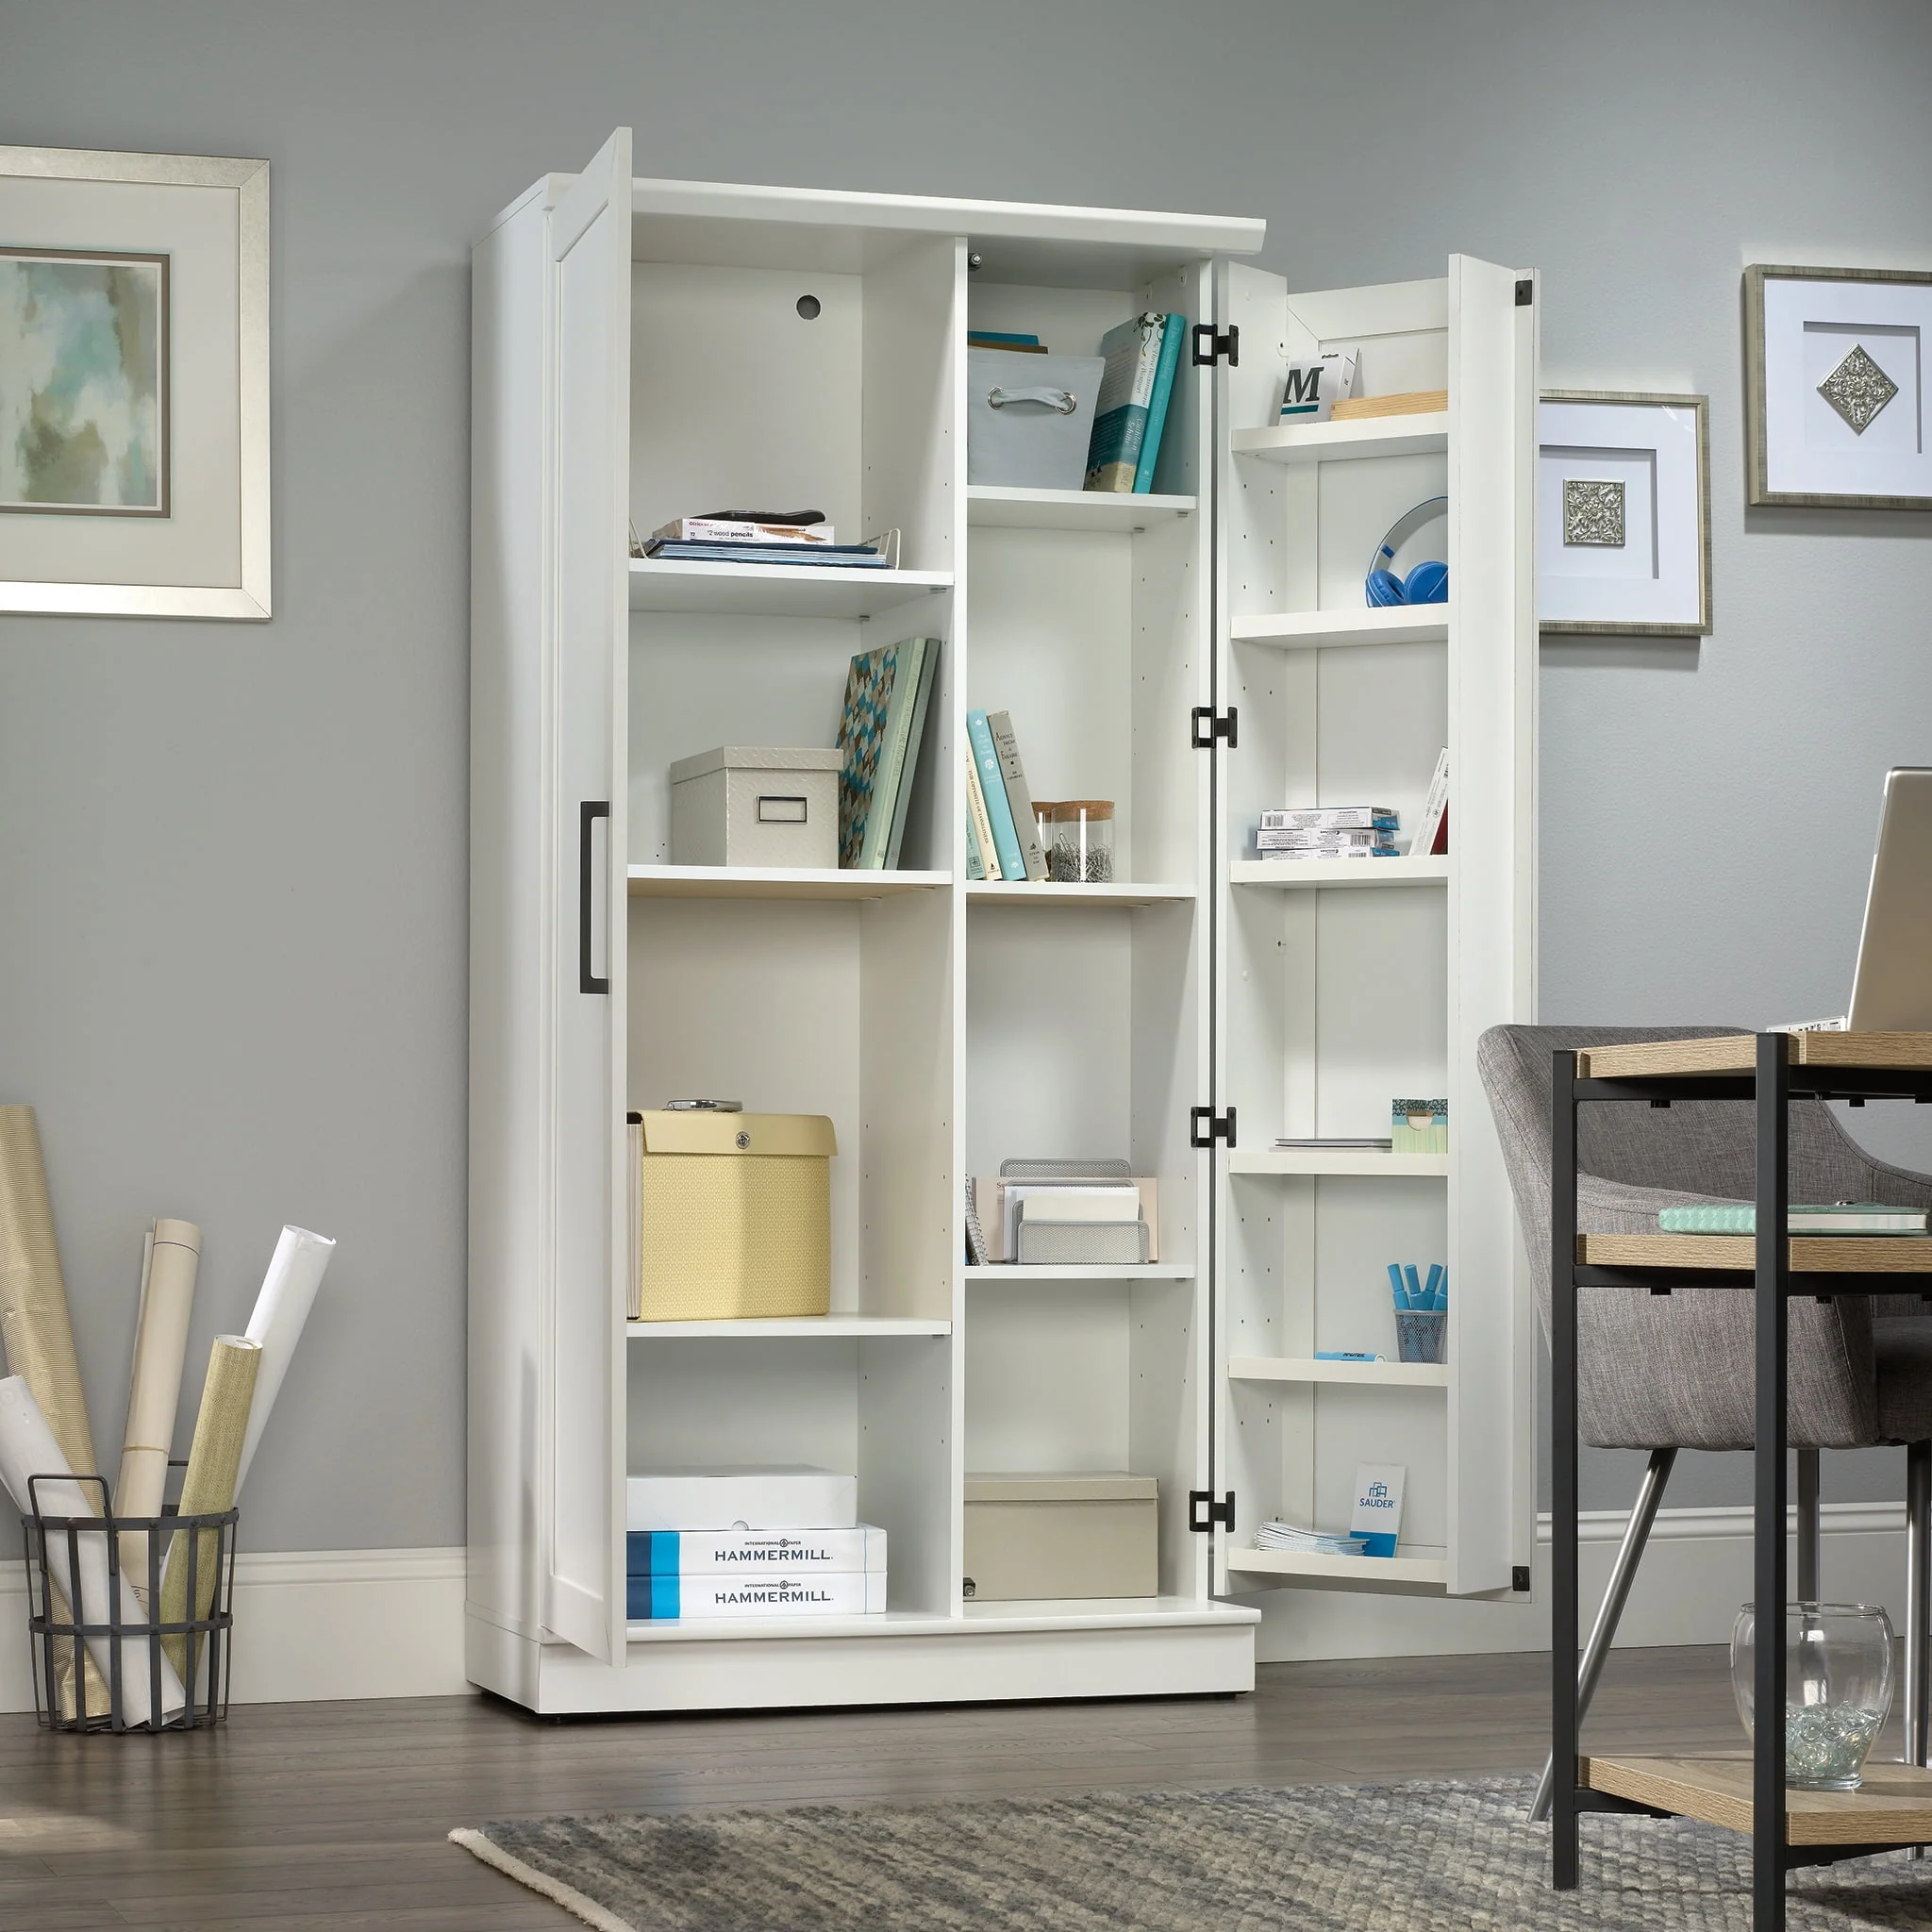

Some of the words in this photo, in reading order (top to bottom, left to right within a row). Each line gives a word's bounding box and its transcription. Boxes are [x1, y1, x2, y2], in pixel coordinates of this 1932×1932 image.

[1283, 366, 1324, 404] M
[1359, 1497, 1394, 1508] SAUDER
[715, 1549, 832, 1562] HAMMERMILL
[715, 1591, 833, 1604] HAMMERMILL
